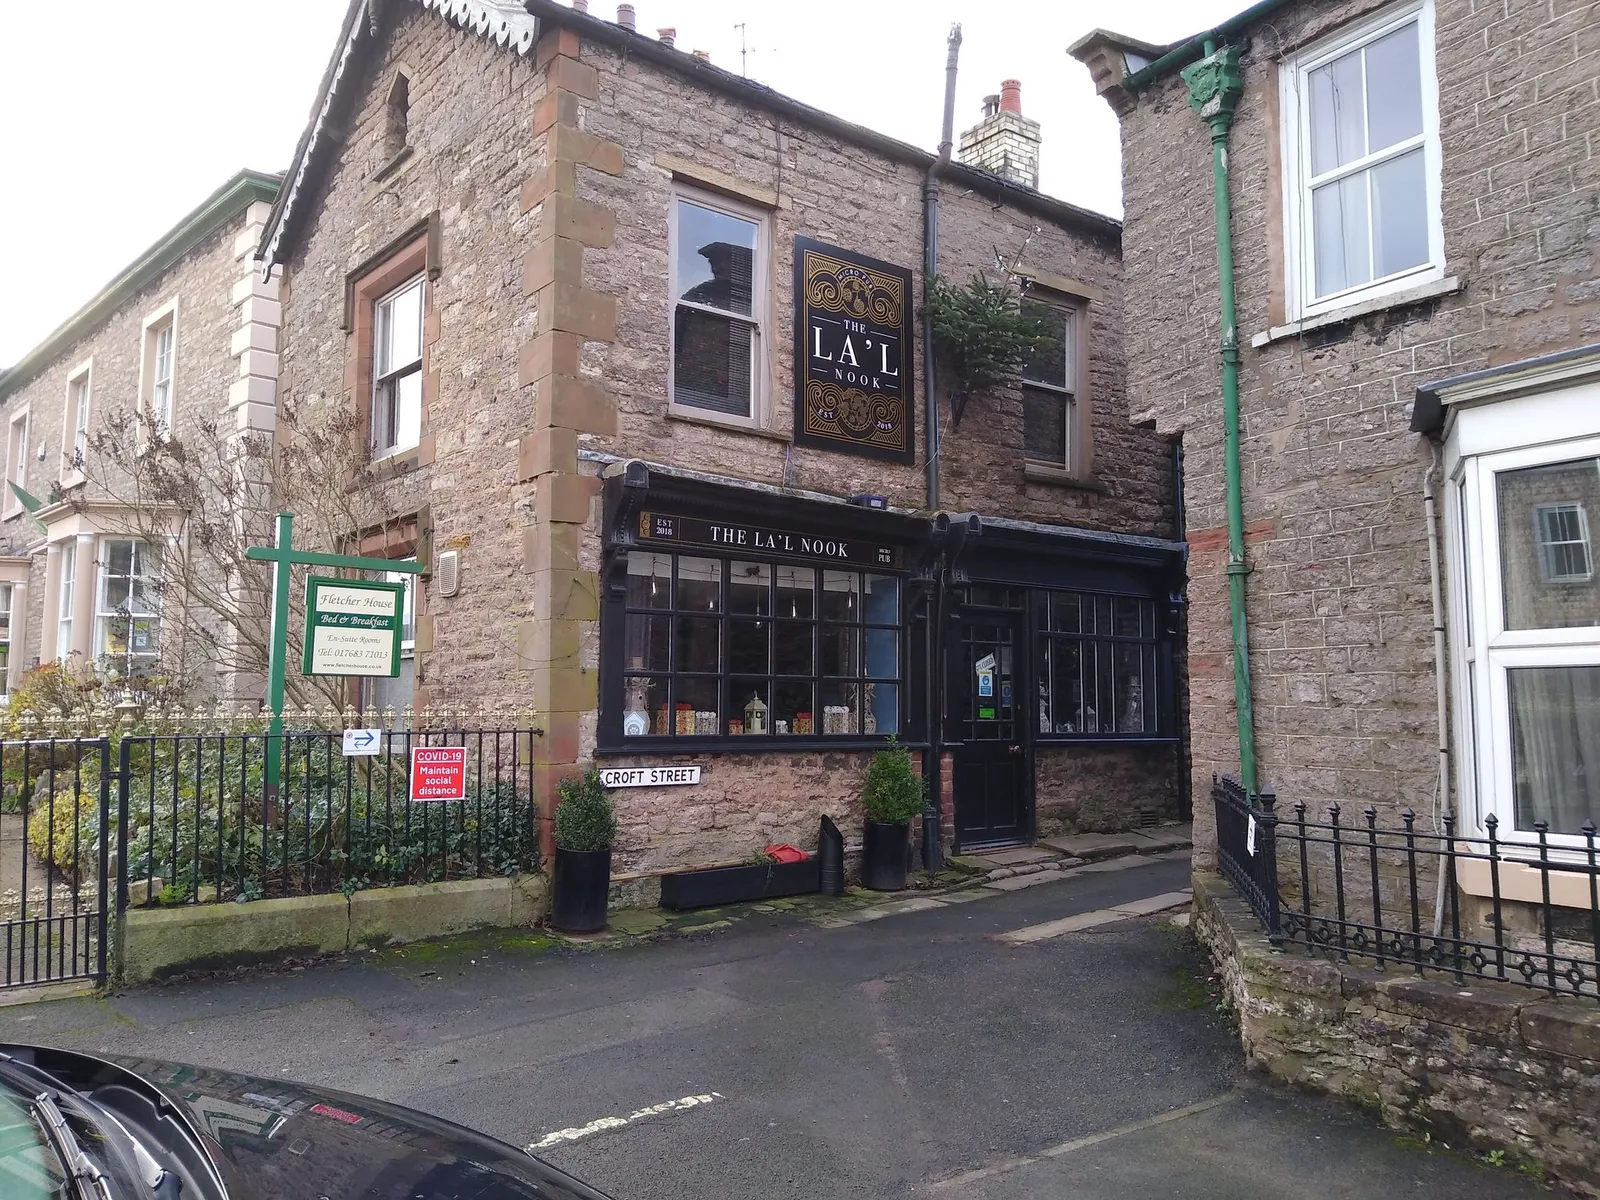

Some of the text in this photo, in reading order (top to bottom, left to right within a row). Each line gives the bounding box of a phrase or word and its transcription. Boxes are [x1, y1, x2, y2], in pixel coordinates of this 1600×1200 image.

[838, 270, 873, 289] MICRO PUB
[843, 319, 867, 334] THE
[835, 368, 881, 389] NOOK
[818, 407, 834, 419] EST
[876, 420, 893, 431] 2018
[656, 518, 673, 528] EST
[655, 526, 673, 536] 2018
[710, 525, 848, 558] THE LA'L NOOK
[878, 554, 891, 563] PUB
[320, 593, 393, 609] Fletcher House
[320, 614, 389, 629] Bed & Breakfast
[326, 634, 381, 645] En-Suite Rooms
[317, 648, 389, 659] Tel: 017683 71013
[417, 752, 462, 761] COVID-19
[420, 766, 459, 775] Maintain
[425, 777, 452, 785] social
[605, 769, 695, 784] CROFT STREET
[419, 786, 457, 796] distance
